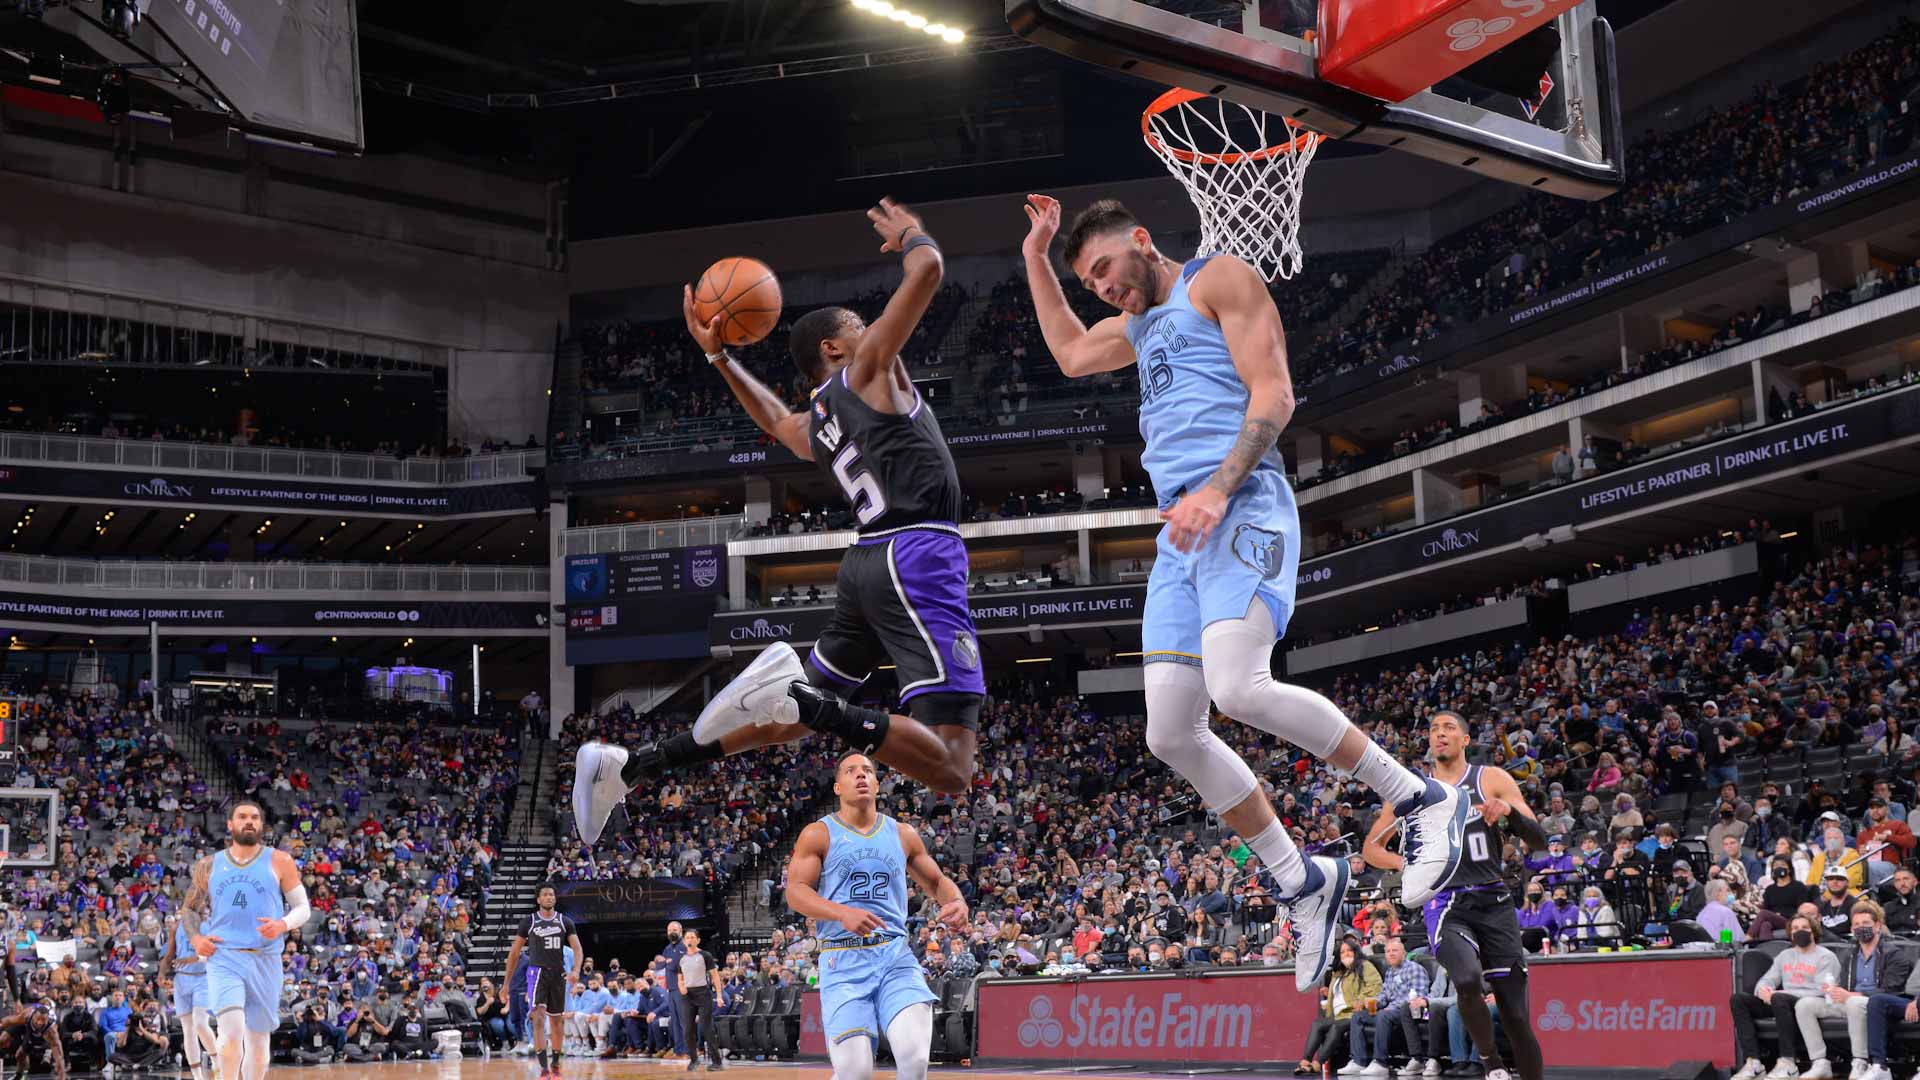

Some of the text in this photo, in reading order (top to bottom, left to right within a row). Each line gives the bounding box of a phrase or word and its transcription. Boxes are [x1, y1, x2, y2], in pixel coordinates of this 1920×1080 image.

[1797, 159, 1918, 212] CINTRONWORLD.COM
[1510, 256, 1669, 324] LIFESTYLE PARTNER DRINK IT. LIVE IT.
[947, 433, 989, 444] LIFESTYLE
[991, 431, 1030, 442] PARTNER
[1037, 428, 1065, 437] DRINK
[1077, 425, 1097, 433] LIVE
[1098, 424, 1108, 432] IT.
[729, 452, 766, 464] 4:28 PM
[1581, 424, 1849, 509] LIFESTYLE PARTNER DRINK IT. LIVE IT.
[124, 482, 193, 497] CINTRON
[832, 440, 888, 526] 5
[210, 487, 259, 497] LIFESTYLE
[260, 490, 303, 499] PARTNER
[305, 492, 318, 500] OF
[319, 493, 337, 501] THE
[338, 495, 368, 503] KINGS
[375, 496, 404, 505] DRINK
[406, 497, 417, 505] IT.
[417, 498, 438, 506] LIVE
[1422, 529, 1480, 558] CINTRON
[27, 604, 73, 615] PARTNER
[74, 608, 89, 617] OF
[90, 608, 109, 617] THE
[110, 609, 140, 618] KINGS
[148, 609, 178, 618] DRINK
[180, 610, 190, 618] IT.
[191, 610, 213, 618] LIVE
[214, 610, 225, 618] IT.
[315, 611, 396, 620] @CINTRONWORLD
[969, 598, 1134, 619] ARTNER DRINK IT. LIVE IT.
[730, 622, 793, 640] CINTRON
[1467, 832, 1489, 862] 0
[839, 847, 901, 881] GRIZZLIES
[215, 874, 266, 897] GRIZZLIES
[850, 871, 890, 901] 22
[231, 889, 248, 910] 4
[544, 937, 561, 950] 30
